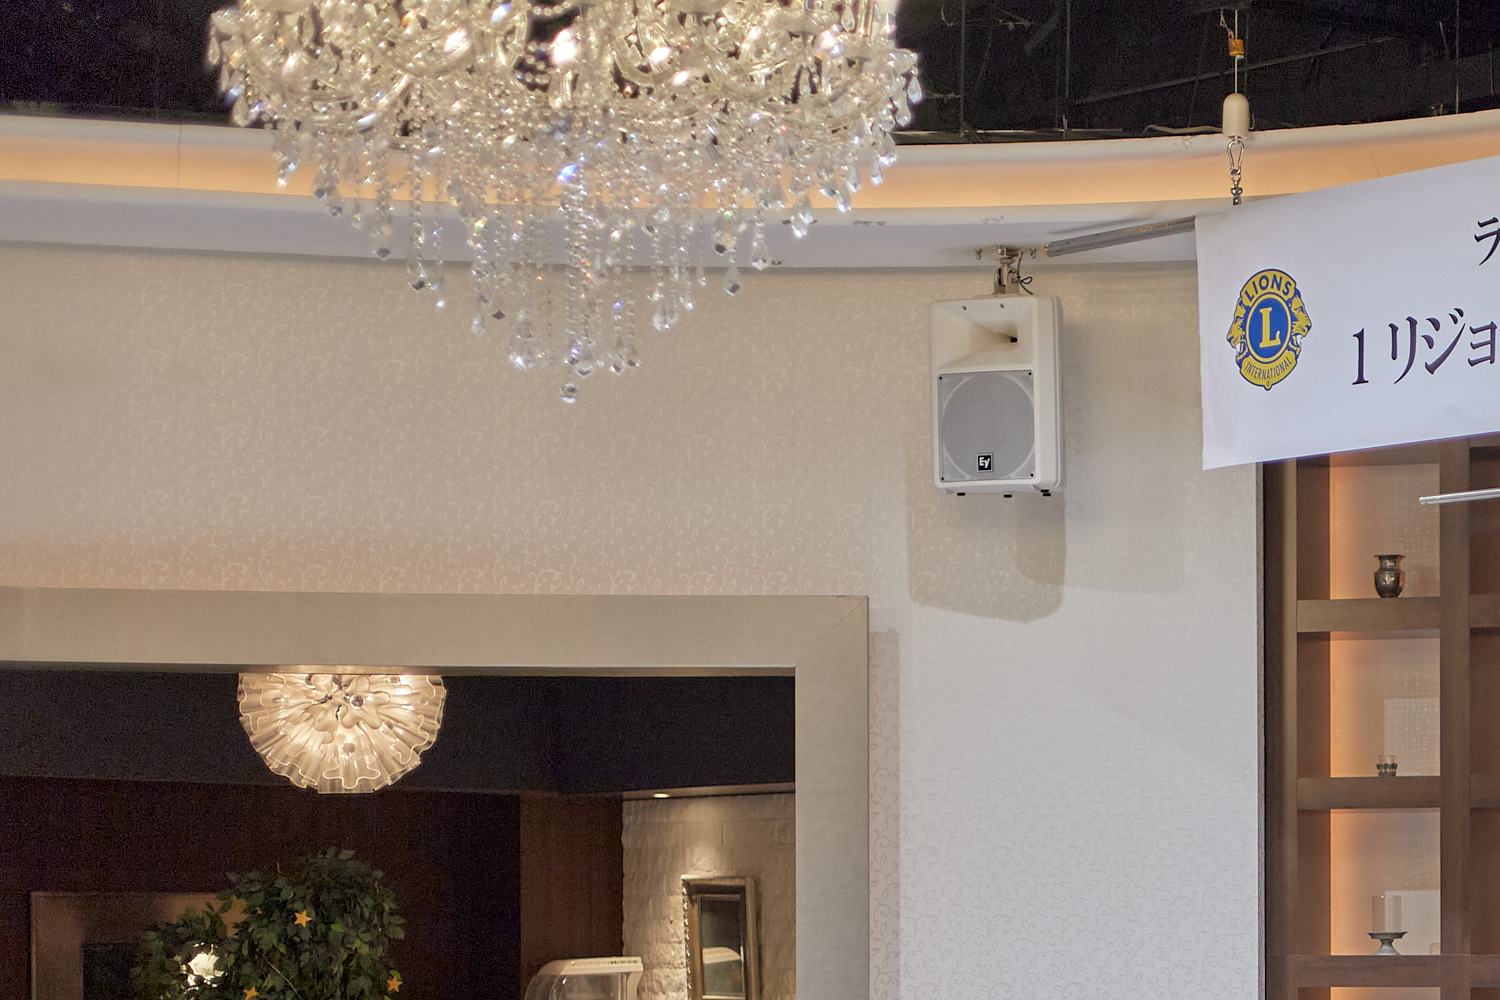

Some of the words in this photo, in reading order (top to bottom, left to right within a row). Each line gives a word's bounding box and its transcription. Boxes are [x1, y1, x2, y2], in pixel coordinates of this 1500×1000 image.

[1244, 274, 1292, 303] LIONS
[1259, 307, 1281, 348] L
[1244, 356, 1293, 380] INTERNATIONAL
